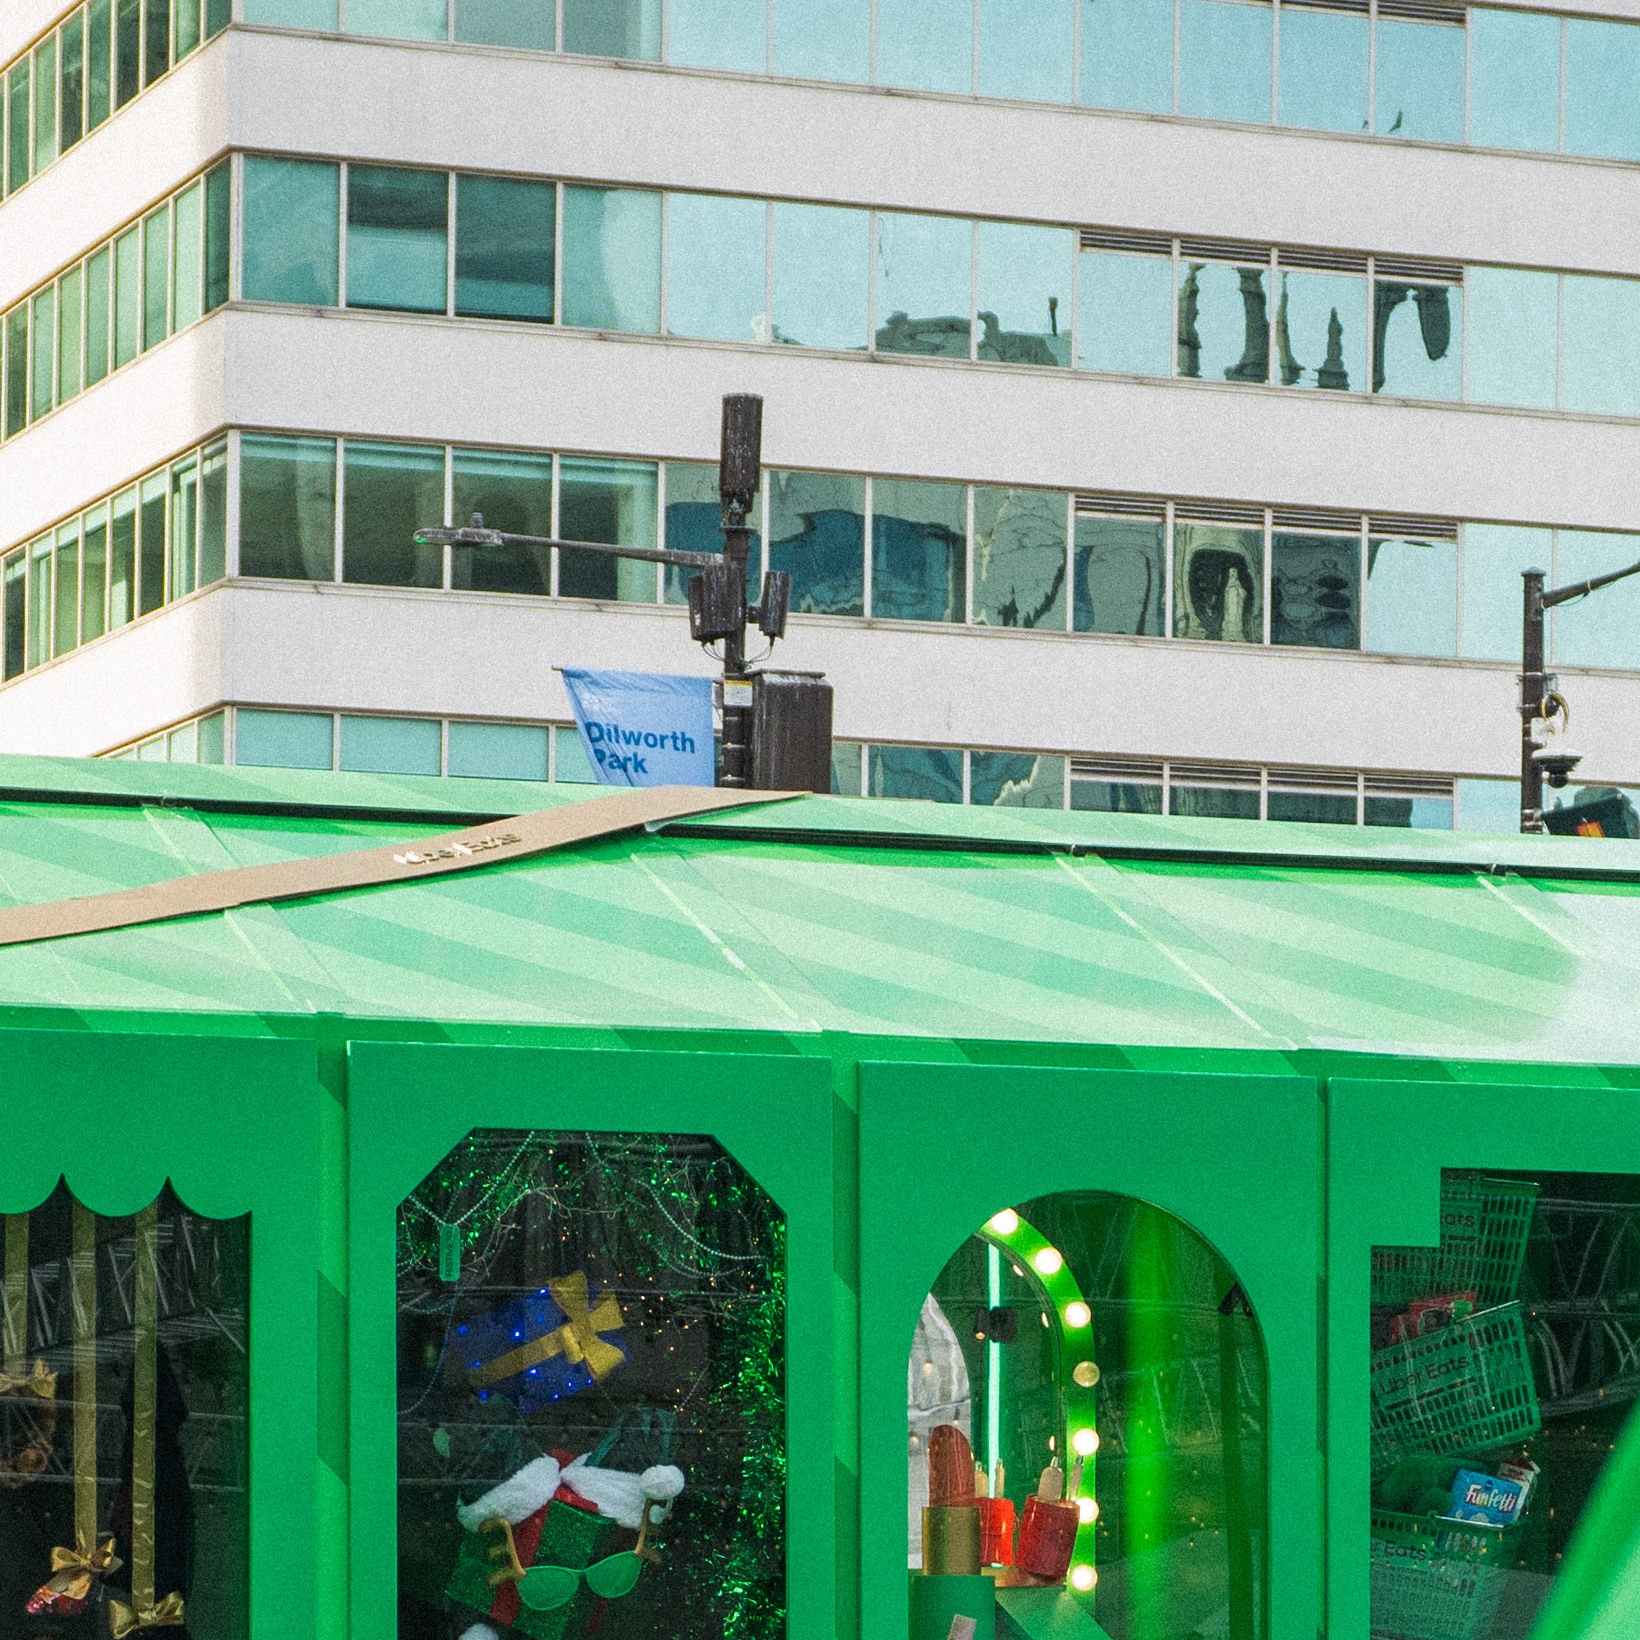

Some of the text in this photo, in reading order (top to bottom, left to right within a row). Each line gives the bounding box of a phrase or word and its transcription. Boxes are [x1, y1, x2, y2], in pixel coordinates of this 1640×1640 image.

[584, 721, 696, 754] Dilworth
[1440, 1213, 1476, 1228] ats
[1379, 1355, 1470, 1395] Uber Eats
[1464, 1484, 1518, 1513] Funfetti
[1383, 1540, 1427, 1561] Eats
